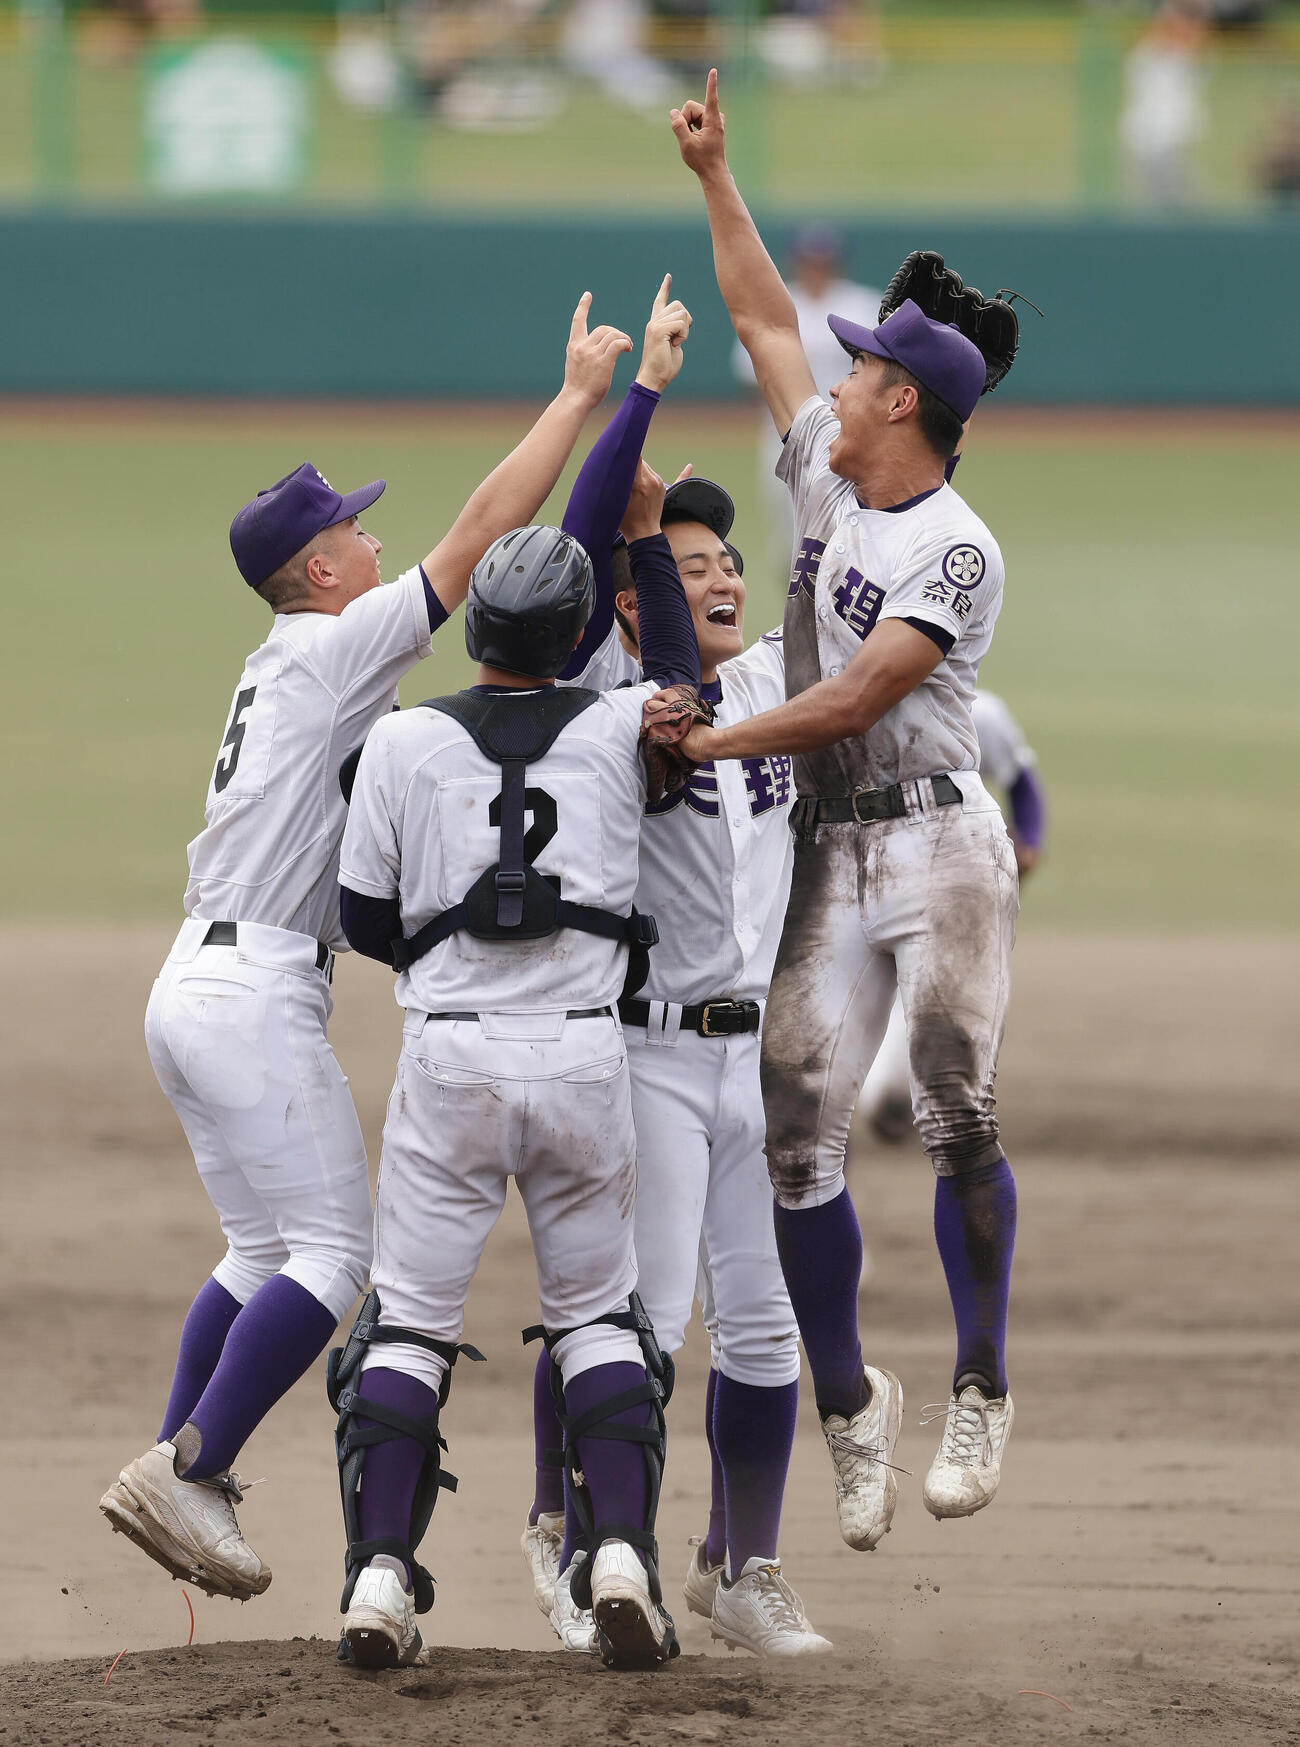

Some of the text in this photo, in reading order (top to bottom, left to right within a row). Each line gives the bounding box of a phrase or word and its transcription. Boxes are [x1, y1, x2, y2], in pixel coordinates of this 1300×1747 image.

[920, 578, 975, 623] 奈良
[214, 684, 258, 795] 5
[488, 786, 562, 901] 2
